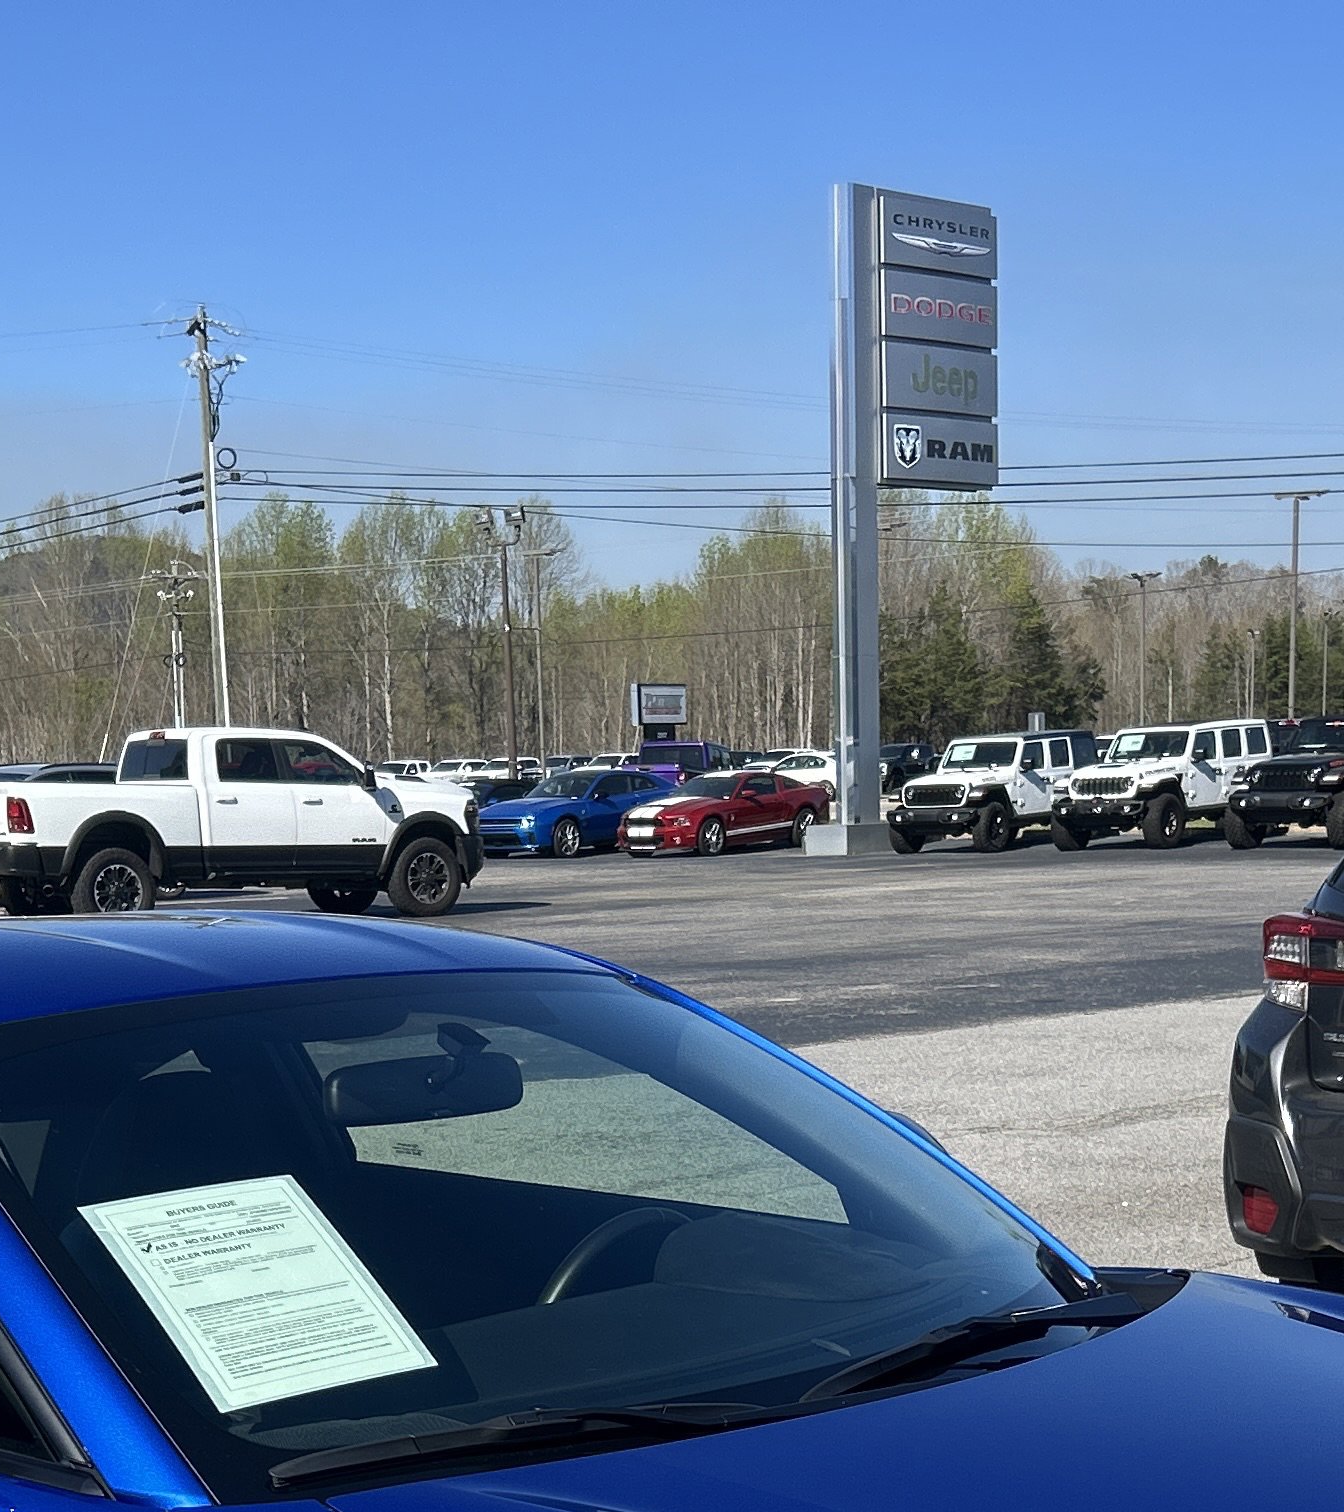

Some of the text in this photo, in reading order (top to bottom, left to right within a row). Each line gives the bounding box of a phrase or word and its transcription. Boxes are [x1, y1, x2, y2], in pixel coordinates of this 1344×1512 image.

[893, 212, 990, 241] CHRYSLER
[891, 292, 993, 326] DODGE
[912, 353, 978, 402] Jeep
[926, 438, 994, 464] RAM
[165, 1199, 237, 1217] BUYERS GUIDE
[156, 1244, 167, 1252] AS
[168, 1241, 179, 1249] IS
[199, 1231, 236, 1242] DEALER
[236, 1223, 286, 1236] WARRANTY
[163, 1242, 252, 1265] DEALER WARRANTY
